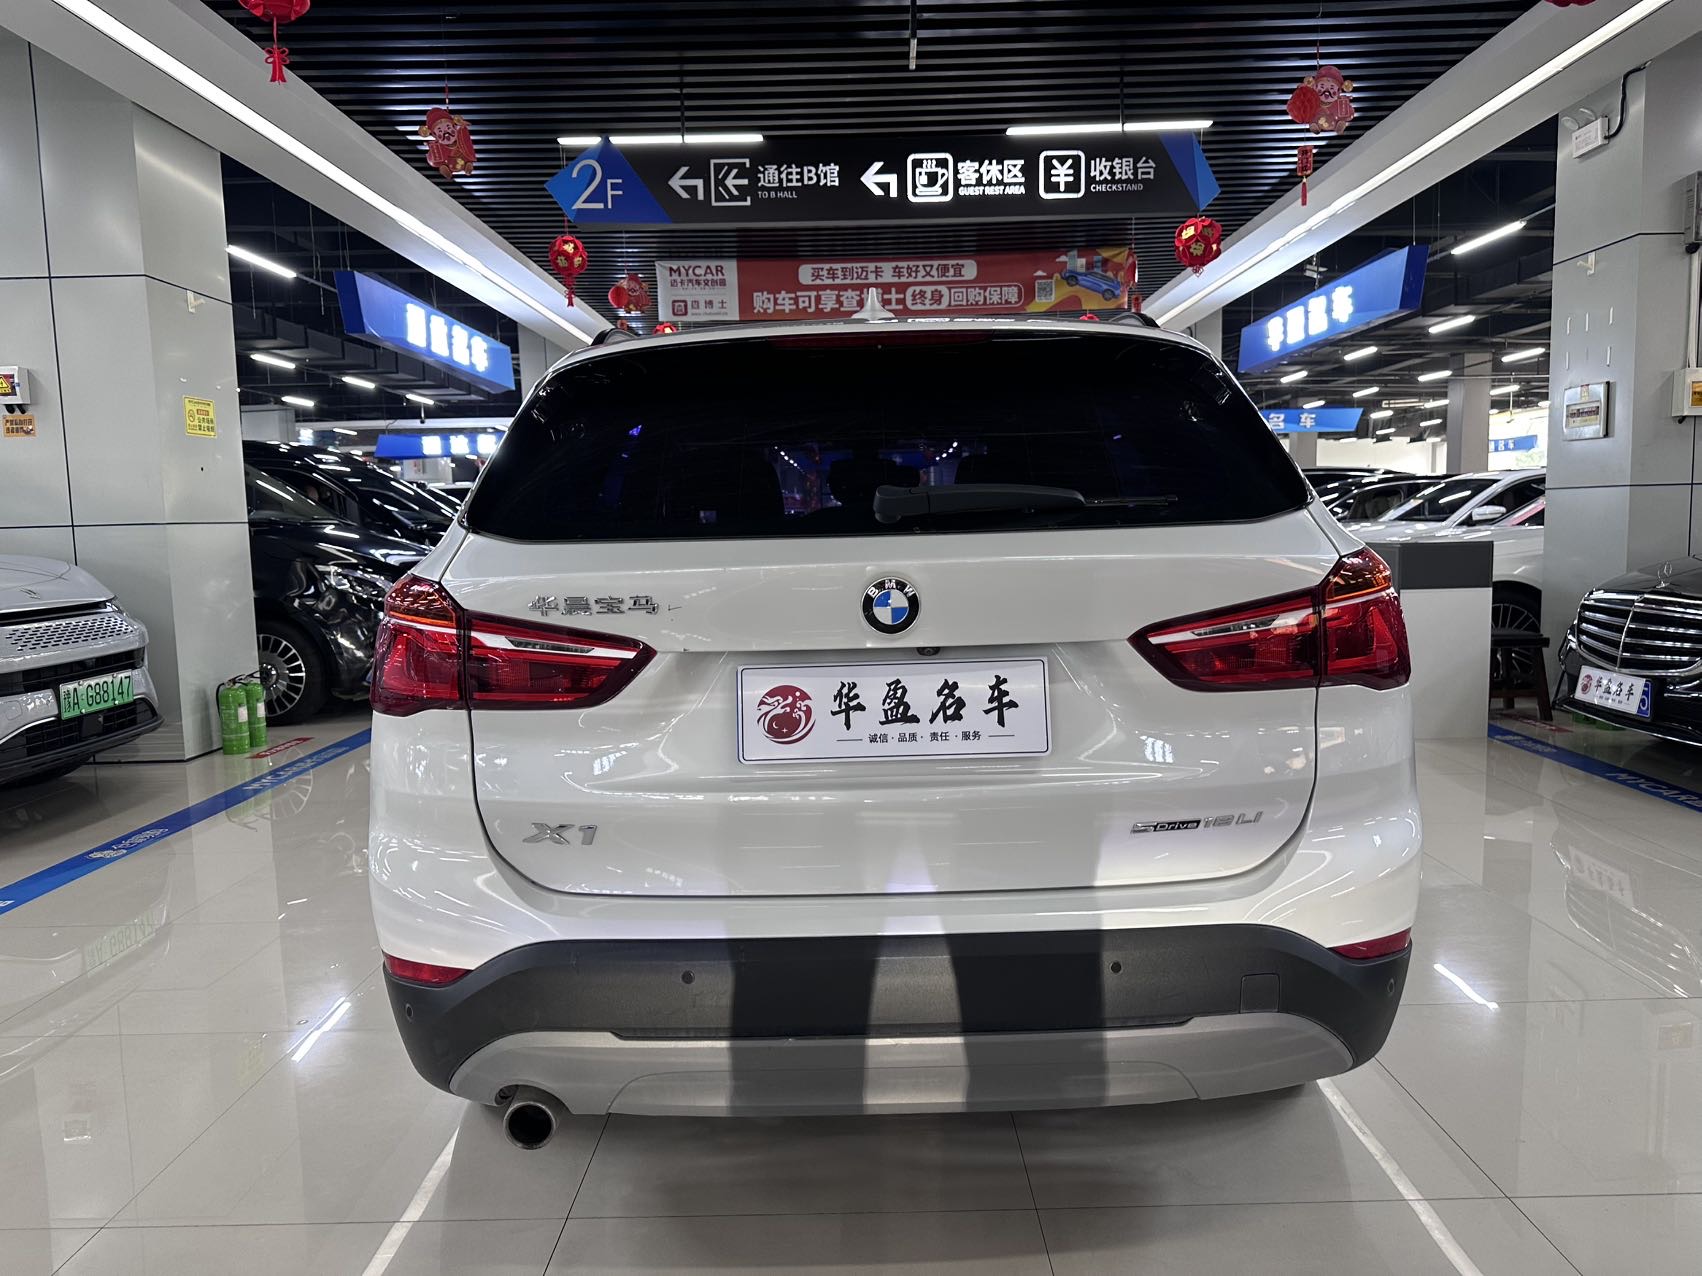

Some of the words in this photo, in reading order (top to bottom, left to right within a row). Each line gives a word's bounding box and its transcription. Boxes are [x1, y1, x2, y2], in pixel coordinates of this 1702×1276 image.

[757, 163, 840, 188] 通往B馆
[957, 159, 1026, 185] 客休区
[1089, 157, 1157, 182] 收银台
[757, 191, 769, 199] TO
[770, 191, 776, 199] B
[777, 190, 798, 199] HALL
[958, 185, 984, 196] GUEST
[984, 185, 1004, 195] REST
[1004, 184, 1026, 195] AREA
[1090, 182, 1144, 193] CHECKSTAND
[669, 264, 725, 277] MYCAR
[811, 264, 885, 283] 买车到迈卡
[891, 262, 966, 280] 车好又便宜
[910, 288, 945, 307] 终身
[951, 286, 1019, 306] 回购保障
[867, 579, 916, 598] BMW
[528, 595, 660, 617] 华晨宝马
[830, 674, 1019, 731] 华盈名车
[522, 822, 598, 845] X1
